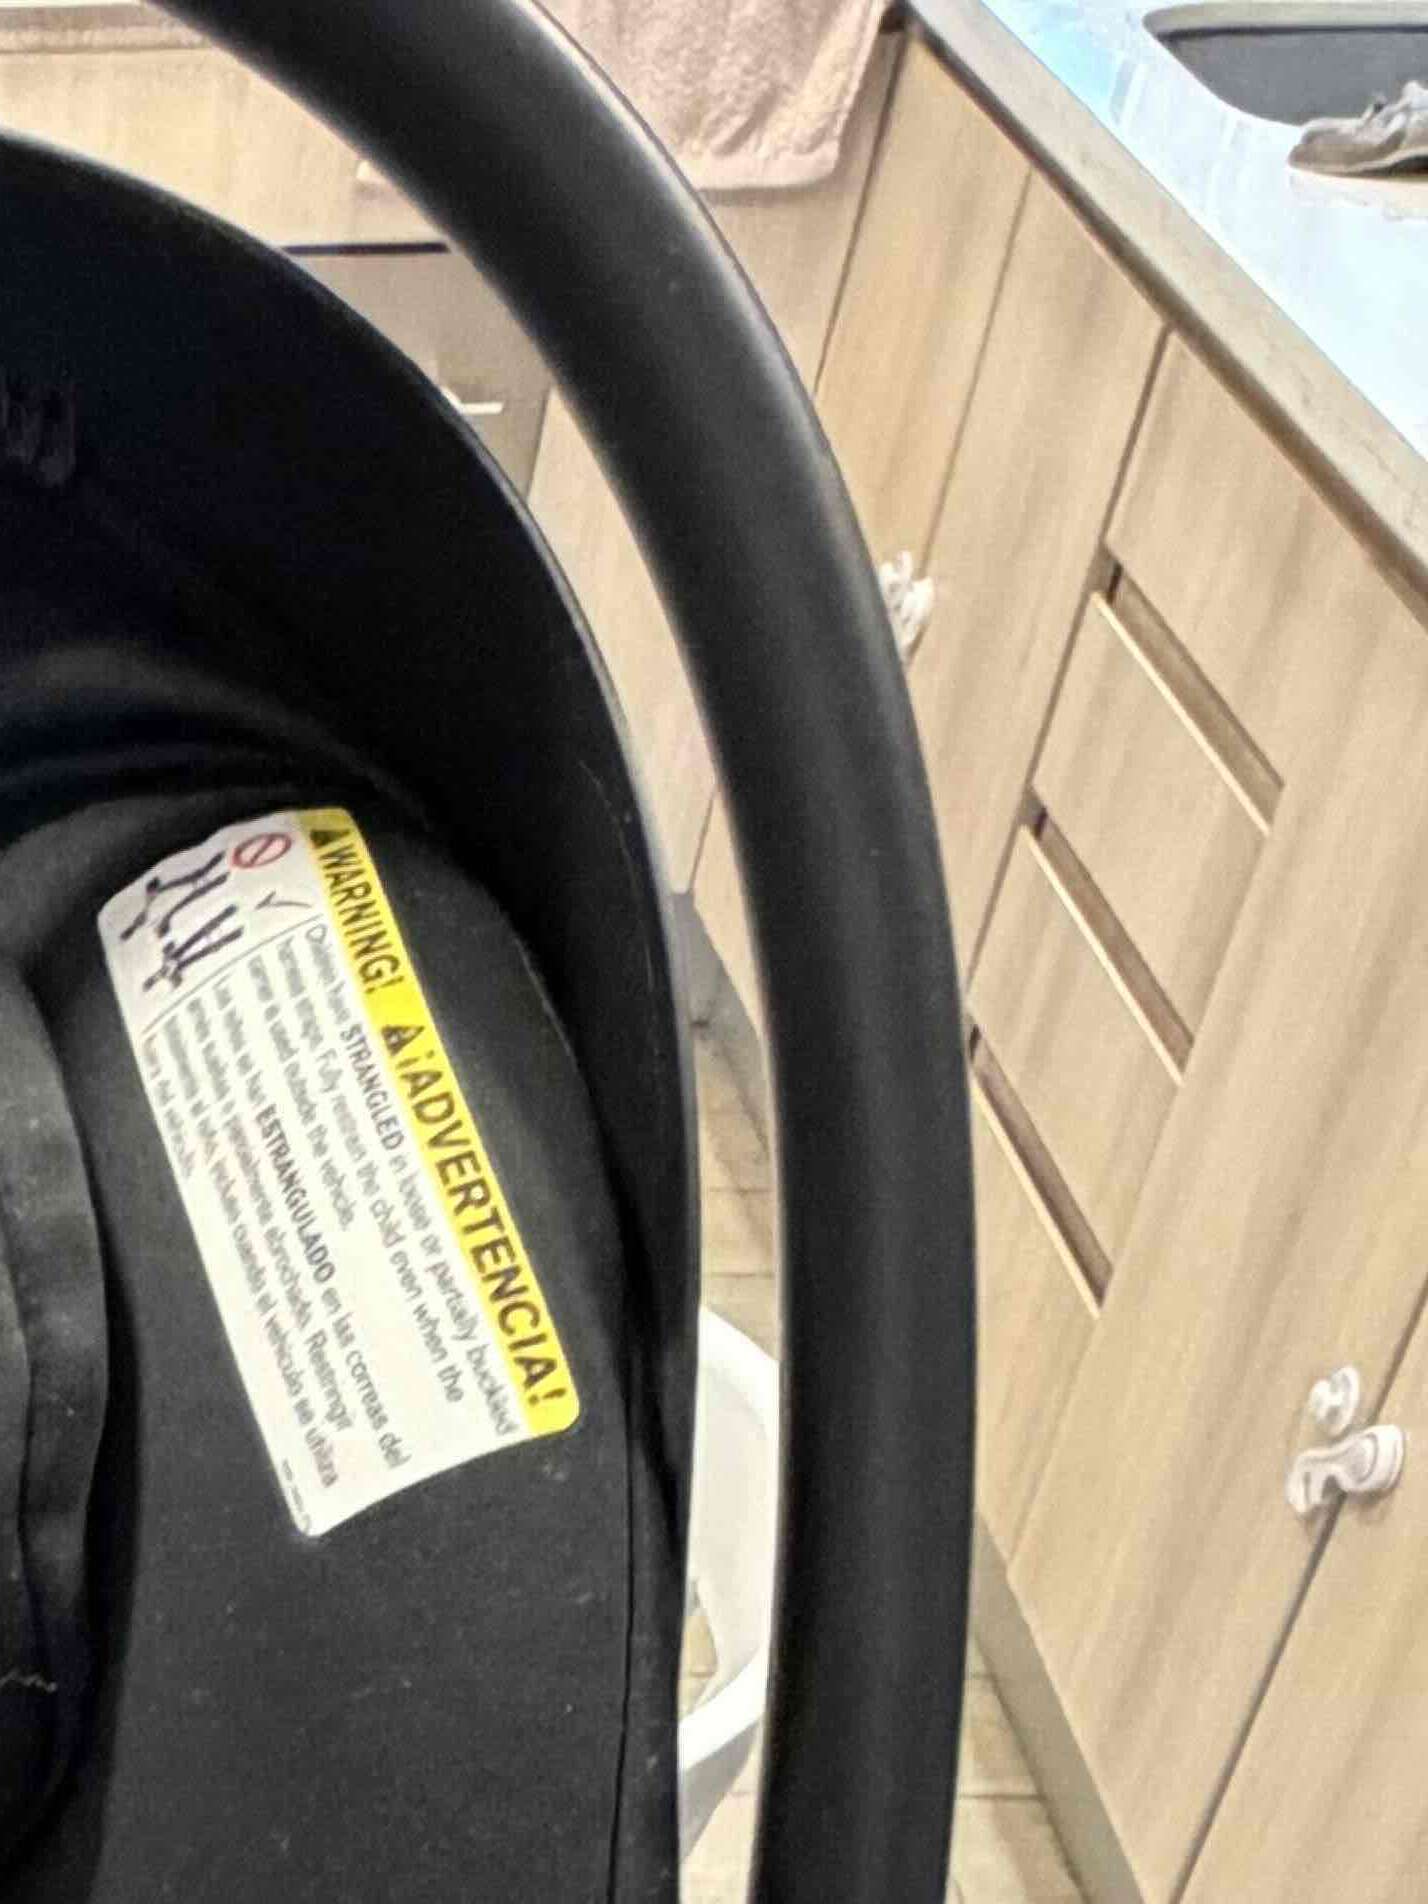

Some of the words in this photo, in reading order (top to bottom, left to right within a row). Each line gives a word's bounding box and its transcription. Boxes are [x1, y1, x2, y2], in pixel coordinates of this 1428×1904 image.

[307, 1124, 329, 1158] the
[319, 844, 403, 993] WARNING!
[401, 1053, 564, 1403] ¡ADVERTENCIA!
[259, 1105, 334, 1283] ESTRANGULADO
[321, 1287, 342, 1315] en
[332, 1312, 355, 1349] las
[347, 1350, 387, 1430] correas
[378, 1433, 411, 1468] del
[340, 1024, 404, 1150] STRANGLED
[425, 1261, 478, 1341] partially
[466, 1344, 517, 1435] buckled
[369, 1199, 406, 1248] child
[390, 1250, 423, 1300] even
[413, 1303, 448, 1363] when
[437, 1364, 464, 1402] the
[305, 1329, 352, 1431] Restringir
[305, 1428, 338, 1488] utiliza
